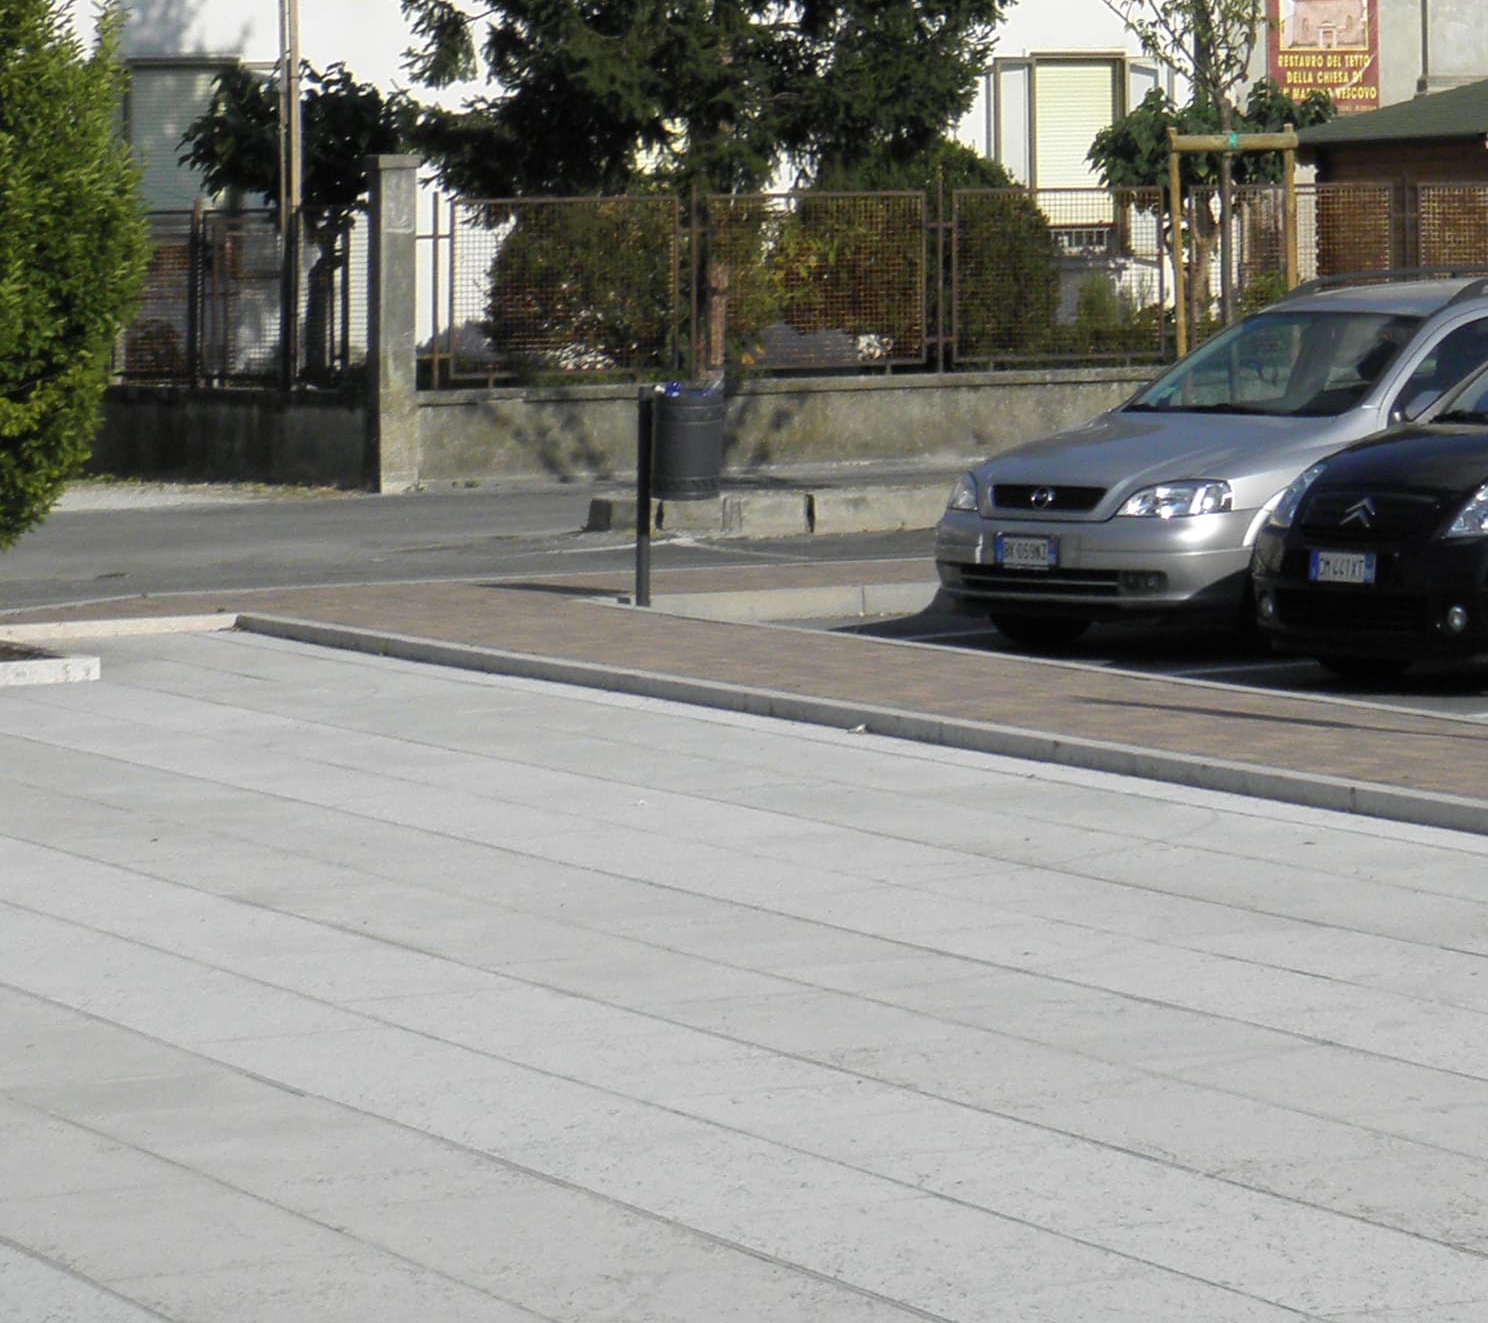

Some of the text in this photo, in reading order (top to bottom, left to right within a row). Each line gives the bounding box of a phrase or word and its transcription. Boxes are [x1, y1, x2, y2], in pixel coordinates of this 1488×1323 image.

[1278, 54, 1371, 68] RESTAURO DEL TETTO
[1286, 70, 1363, 84] DELLA CHIESA DI
[1336, 86, 1377, 100] VESCOVO
